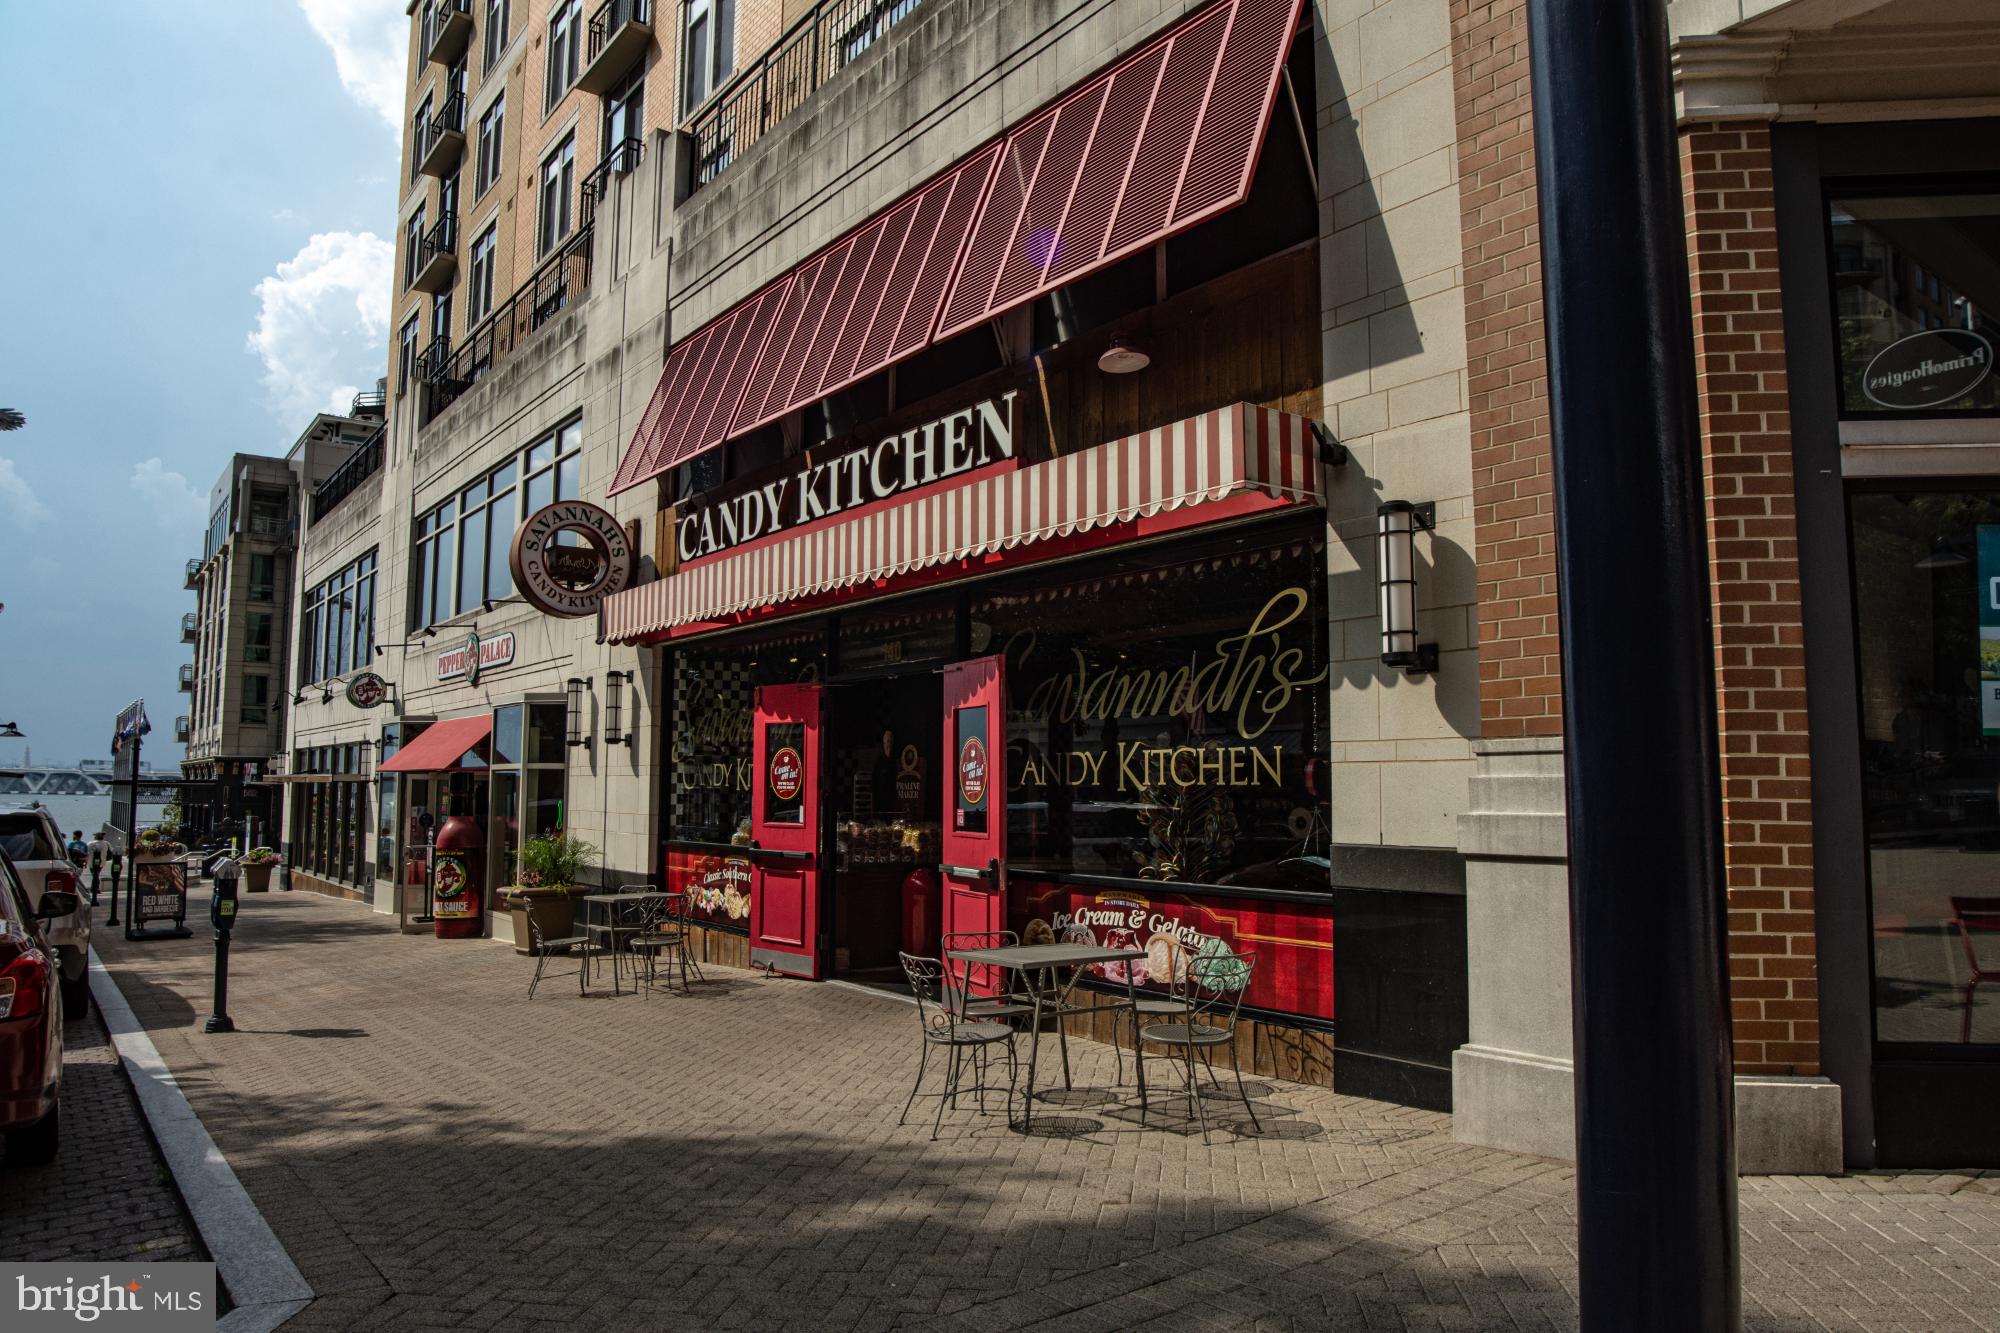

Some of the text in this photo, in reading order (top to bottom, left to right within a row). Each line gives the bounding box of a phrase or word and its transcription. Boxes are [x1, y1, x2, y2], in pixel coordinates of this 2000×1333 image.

[678, 389, 1019, 562] CANDY KITCHEN
[525, 506, 625, 558] SAVANNAH'S
[528, 560, 624, 608] CANDY KITCHEN
[438, 637, 512, 676] PEPPER PALACE
[1116, 741, 1284, 792] KITCHEN
[142, 894, 180, 906] RED WHITE
[142, 905, 154, 913] AND
[444, 901, 468, 912] SAUCE
[1052, 911, 1072, 931] Ice
[1074, 907, 1125, 928] Cream
[1128, 909, 1147, 929] &
